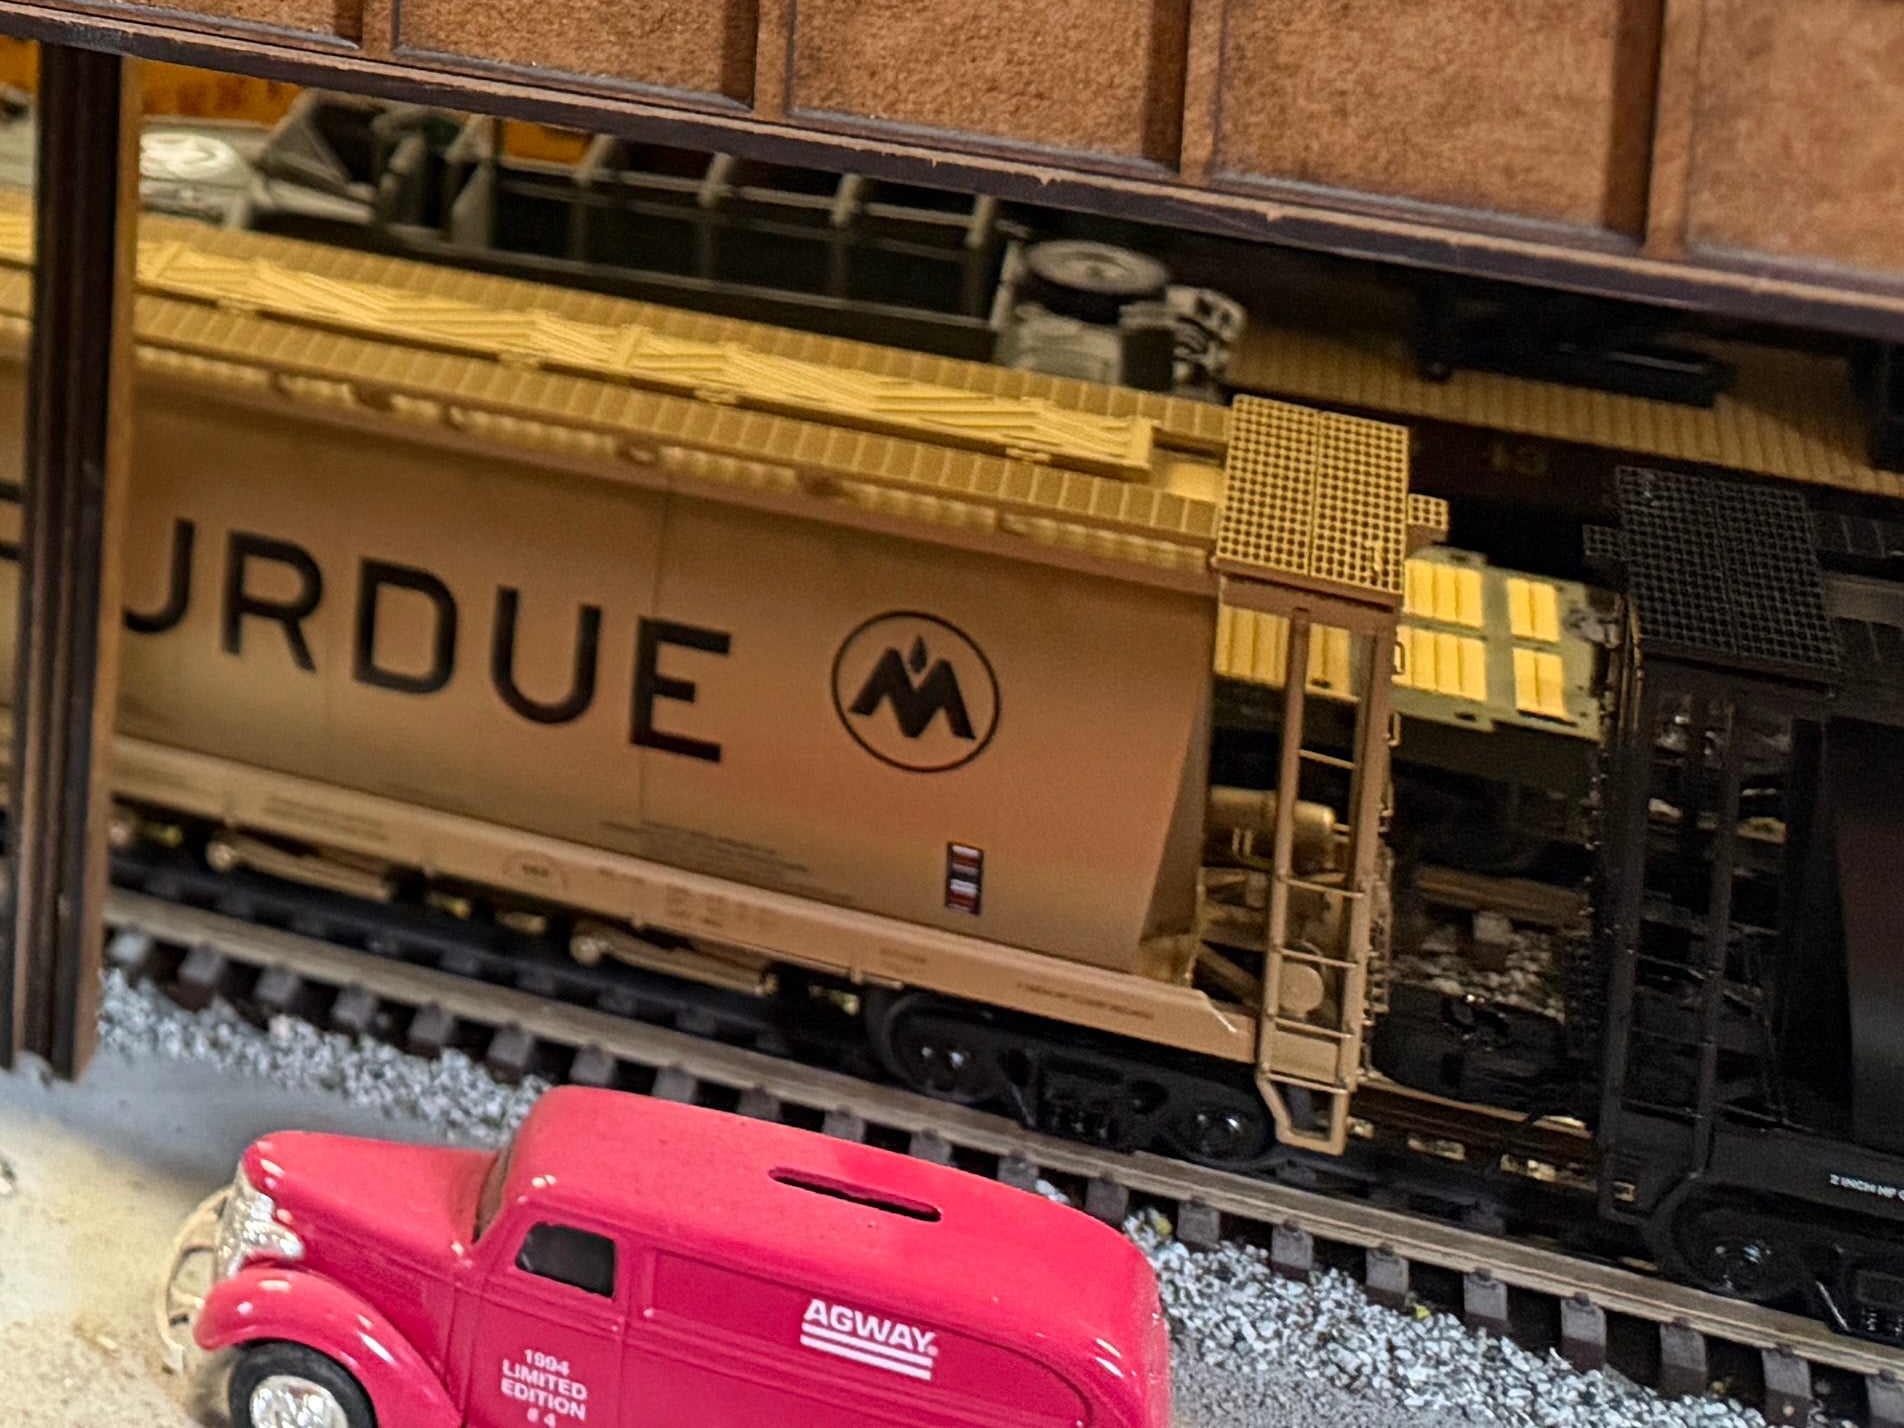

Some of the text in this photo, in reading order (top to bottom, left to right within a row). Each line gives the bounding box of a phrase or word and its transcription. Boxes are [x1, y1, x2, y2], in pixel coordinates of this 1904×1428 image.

[803, 1298, 936, 1356] AGWAY
[502, 1358, 587, 1401] LIMITED
[524, 1349, 570, 1377] 1994
[500, 1377, 586, 1421] EDITION
